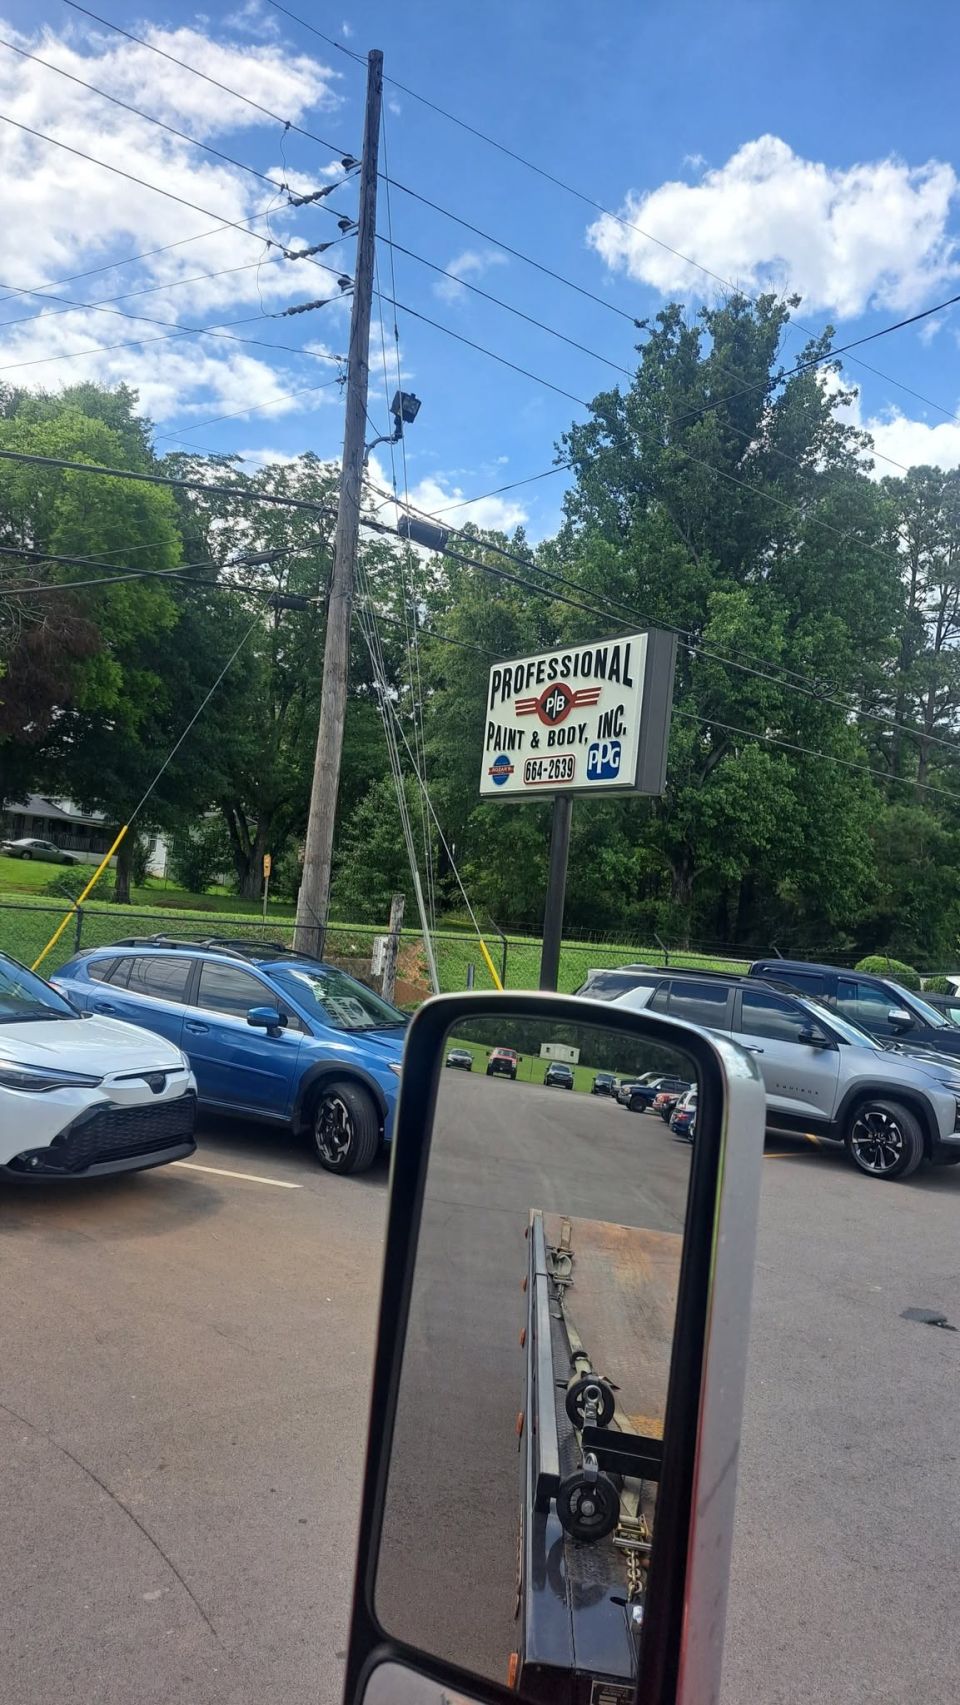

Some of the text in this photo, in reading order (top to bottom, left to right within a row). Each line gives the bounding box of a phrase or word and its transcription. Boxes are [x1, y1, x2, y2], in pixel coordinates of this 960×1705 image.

[489, 642, 634, 711] PROFESSIONAL
[486, 704, 627, 751] PAINT & BODY, INC.
[525, 757, 574, 781] 664-2639
[588, 742, 620, 774] PPG
